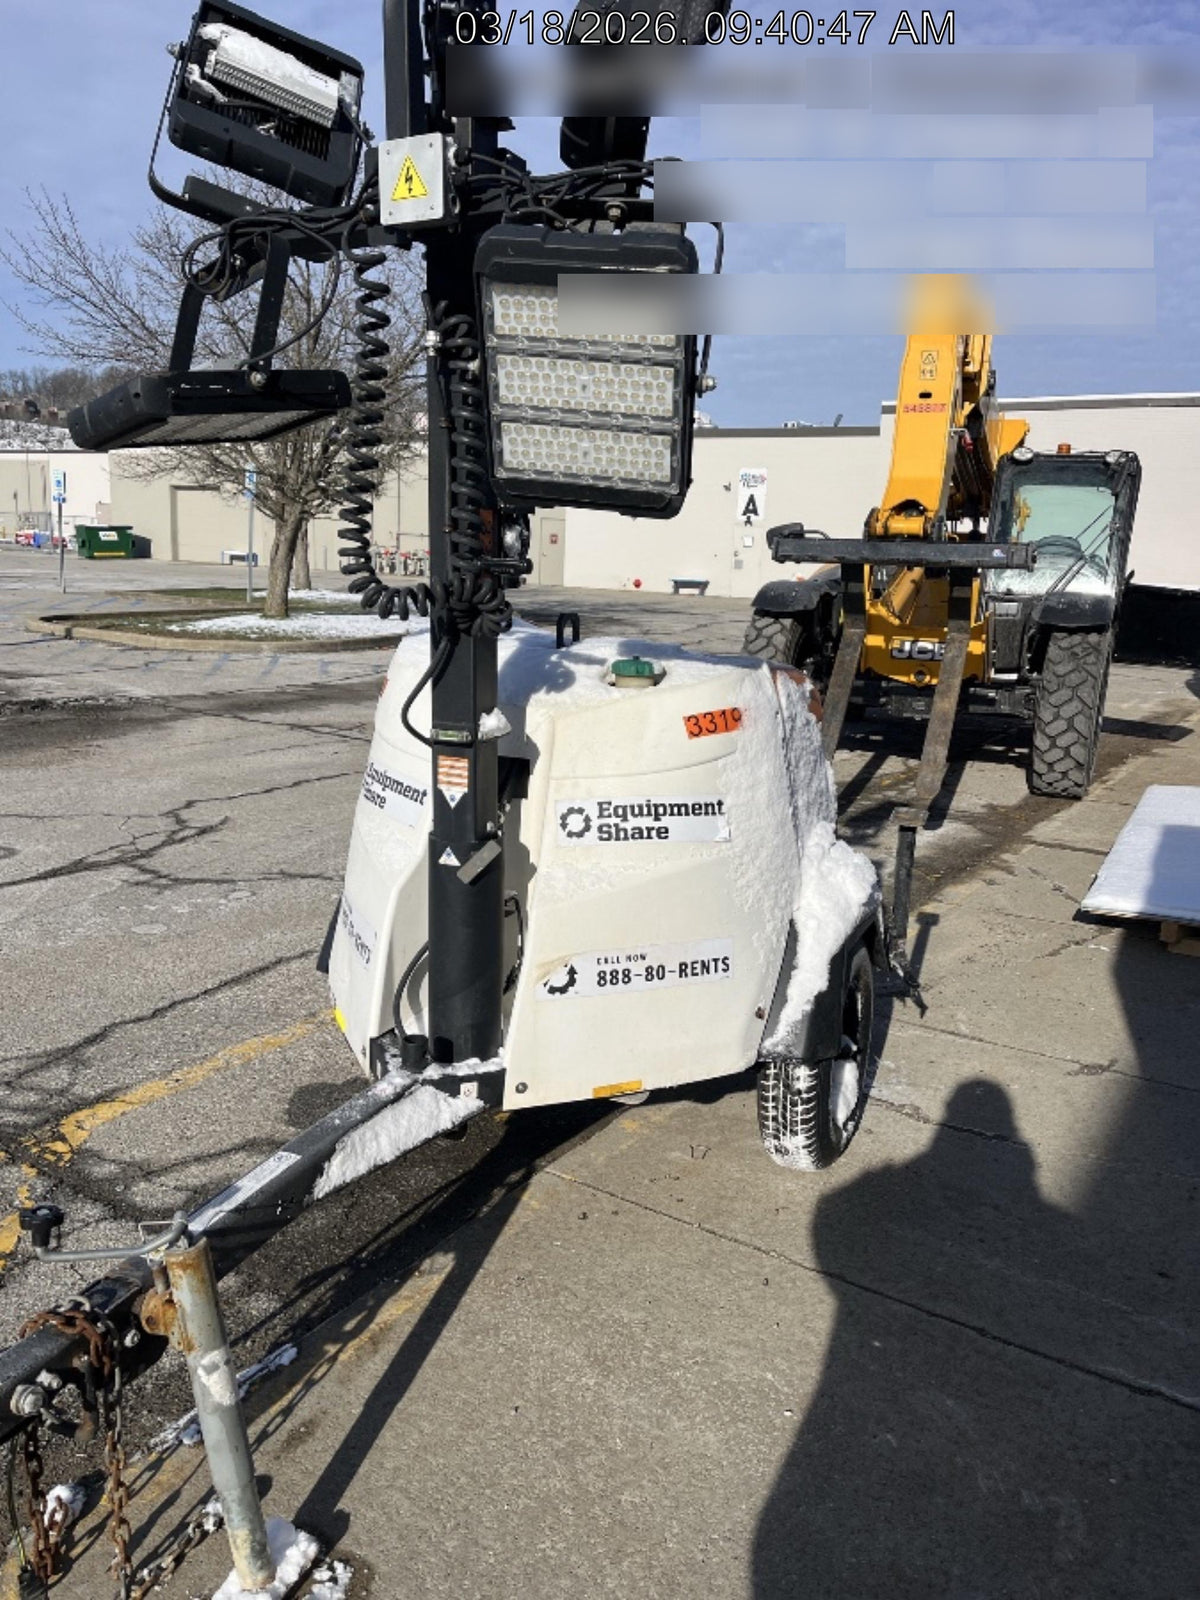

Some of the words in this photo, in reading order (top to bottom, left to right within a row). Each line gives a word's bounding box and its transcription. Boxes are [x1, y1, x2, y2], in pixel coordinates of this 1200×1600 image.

[742, 493, 759, 516] A
[597, 799, 725, 822] Equipment
[597, 824, 669, 842] Share
[597, 956, 622, 966] CALL
[625, 953, 648, 963] NOW
[596, 956, 730, 988] 888-80-RENTS
